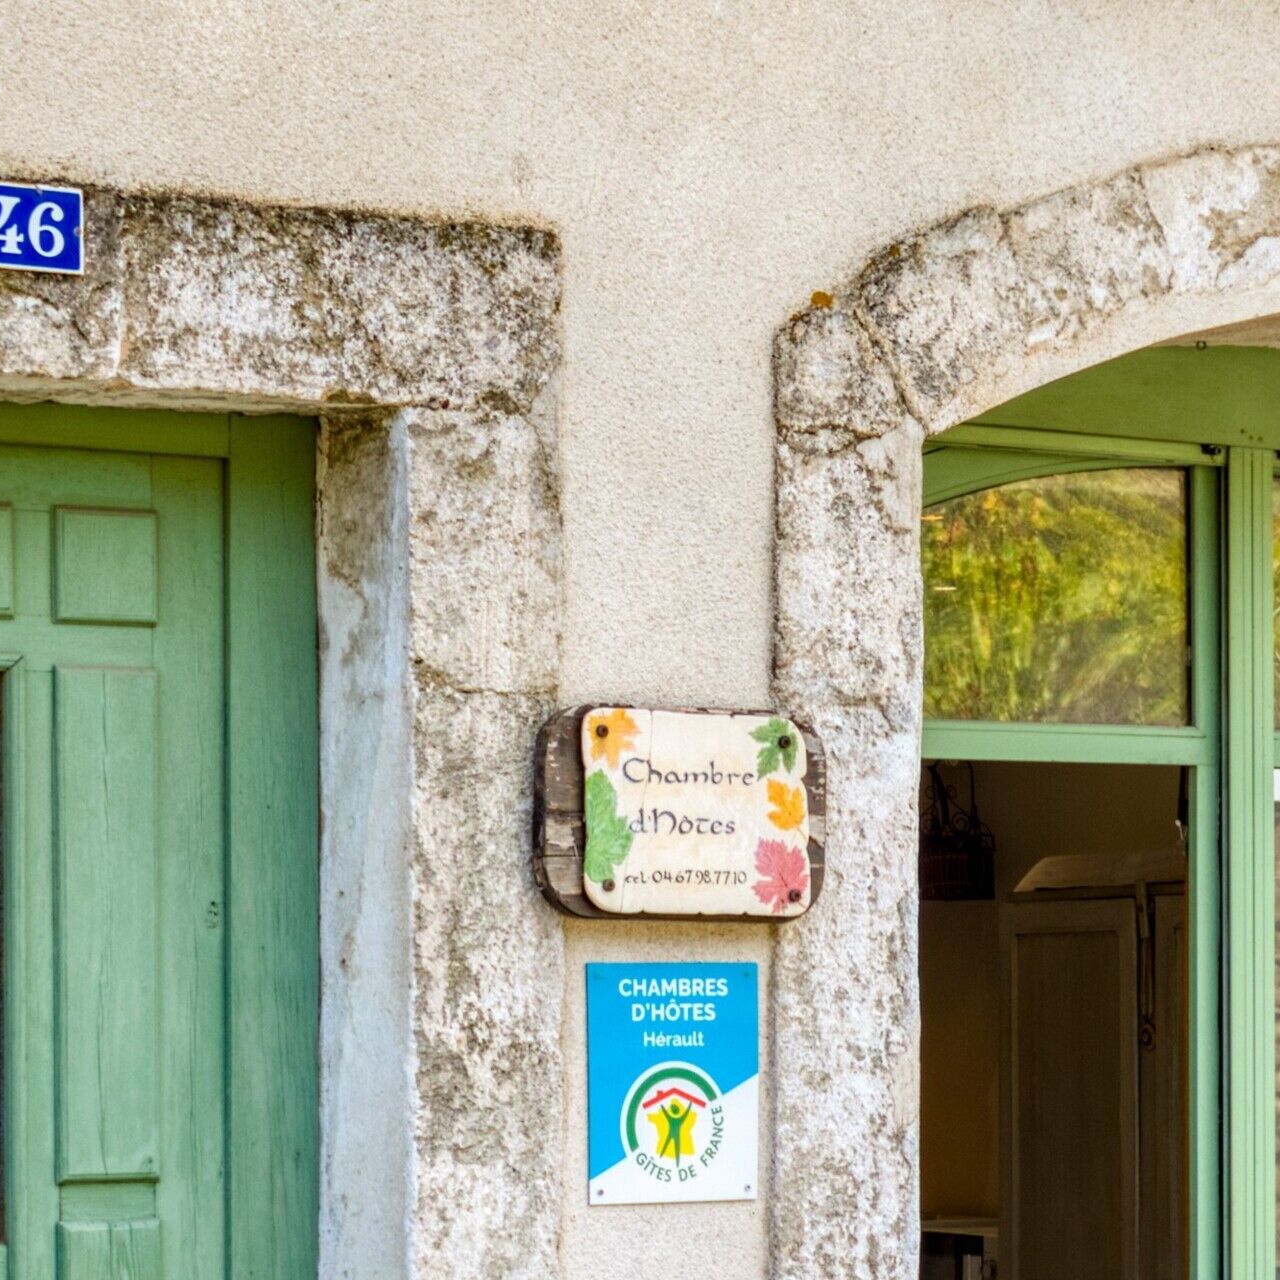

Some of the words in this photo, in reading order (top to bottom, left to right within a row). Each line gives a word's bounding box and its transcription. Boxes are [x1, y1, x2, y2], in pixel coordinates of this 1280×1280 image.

[622, 757, 755, 786] Chambre
[618, 978, 728, 997] CHAMBRES
[631, 999, 716, 1021] D'HÔTES
[643, 1031, 705, 1047] Hérault
[635, 1151, 673, 1183] GÎTES
[678, 1165, 698, 1182] DE
[700, 1105, 725, 1168] FRANCE
